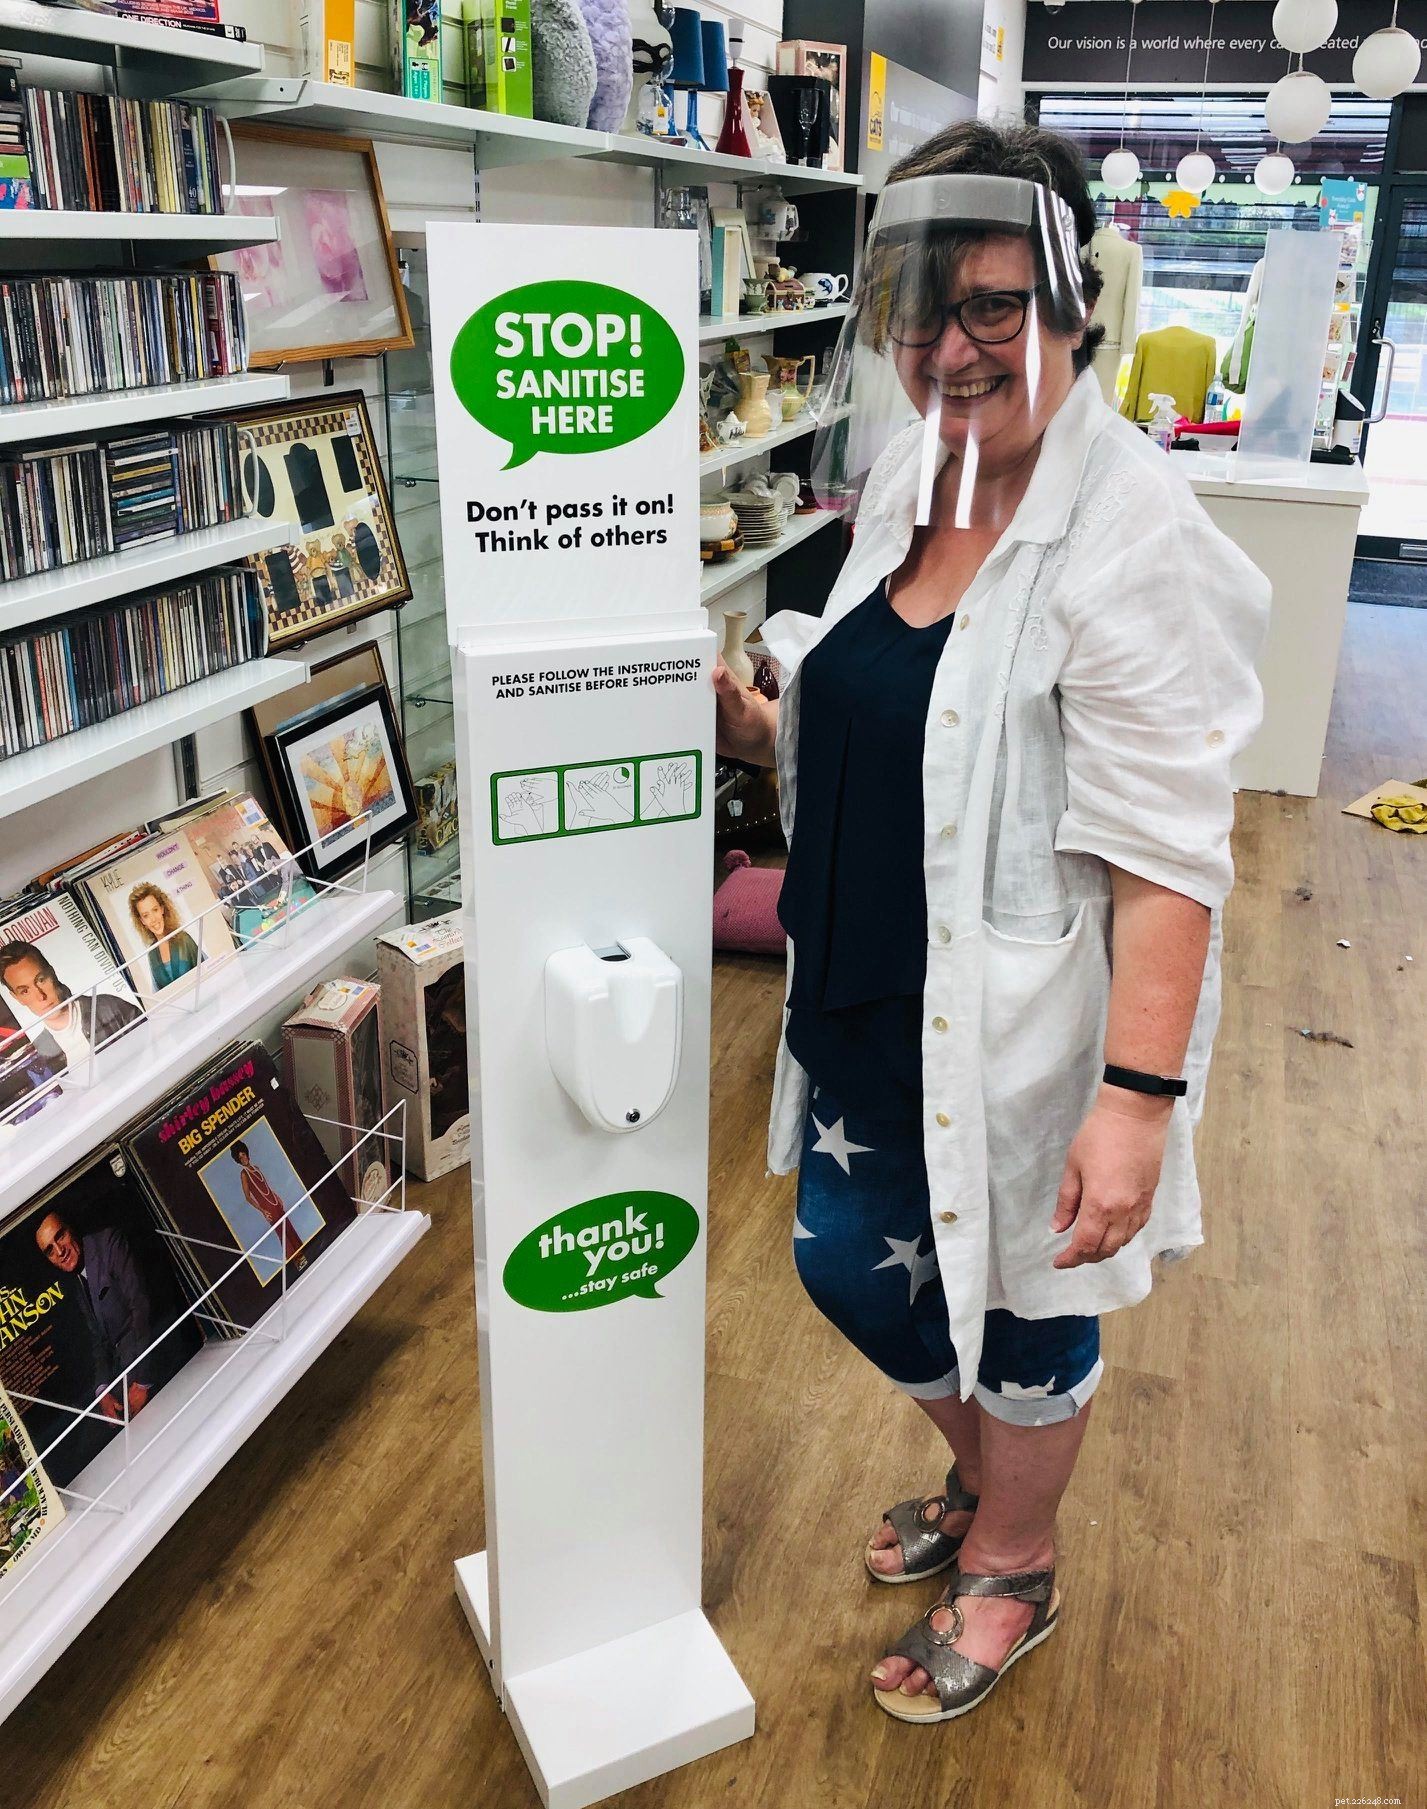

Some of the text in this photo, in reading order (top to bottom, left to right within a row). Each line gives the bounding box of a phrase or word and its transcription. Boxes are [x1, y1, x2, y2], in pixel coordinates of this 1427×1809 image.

[122, 13, 139, 21] ONE
[140, 16, 182, 28] DIRECTION
[1048, 36, 1072, 49] Our
[1076, 36, 1112, 49] vision
[1116, 36, 1126, 49] is
[1129, 40, 1137, 50] a
[1141, 36, 1179, 50] world
[1184, 36, 1225, 49] where
[1229, 38, 1266, 53] every
[494, 312, 642, 358] STOP!
[496, 369, 644, 399] SANITISE
[531, 405, 613, 435] HERE
[466, 493, 674, 525] Don't pass it on!
[475, 525, 668, 553] Think of others
[491, 658, 701, 686] PLEASE FOLLOW THE INSTRUCTIONS
[495, 672, 698, 699] AND SANITISE BEFORE SHOPPING!
[3, 906, 59, 946] DONOVAN
[58, 895, 127, 993] NOTHING CAN DIVID US
[178, 1086, 256, 1155] BIG SPENDER
[539, 1206, 649, 1259] thank
[583, 1222, 665, 1278] you!
[561, 1262, 659, 1300] ...stay safe
